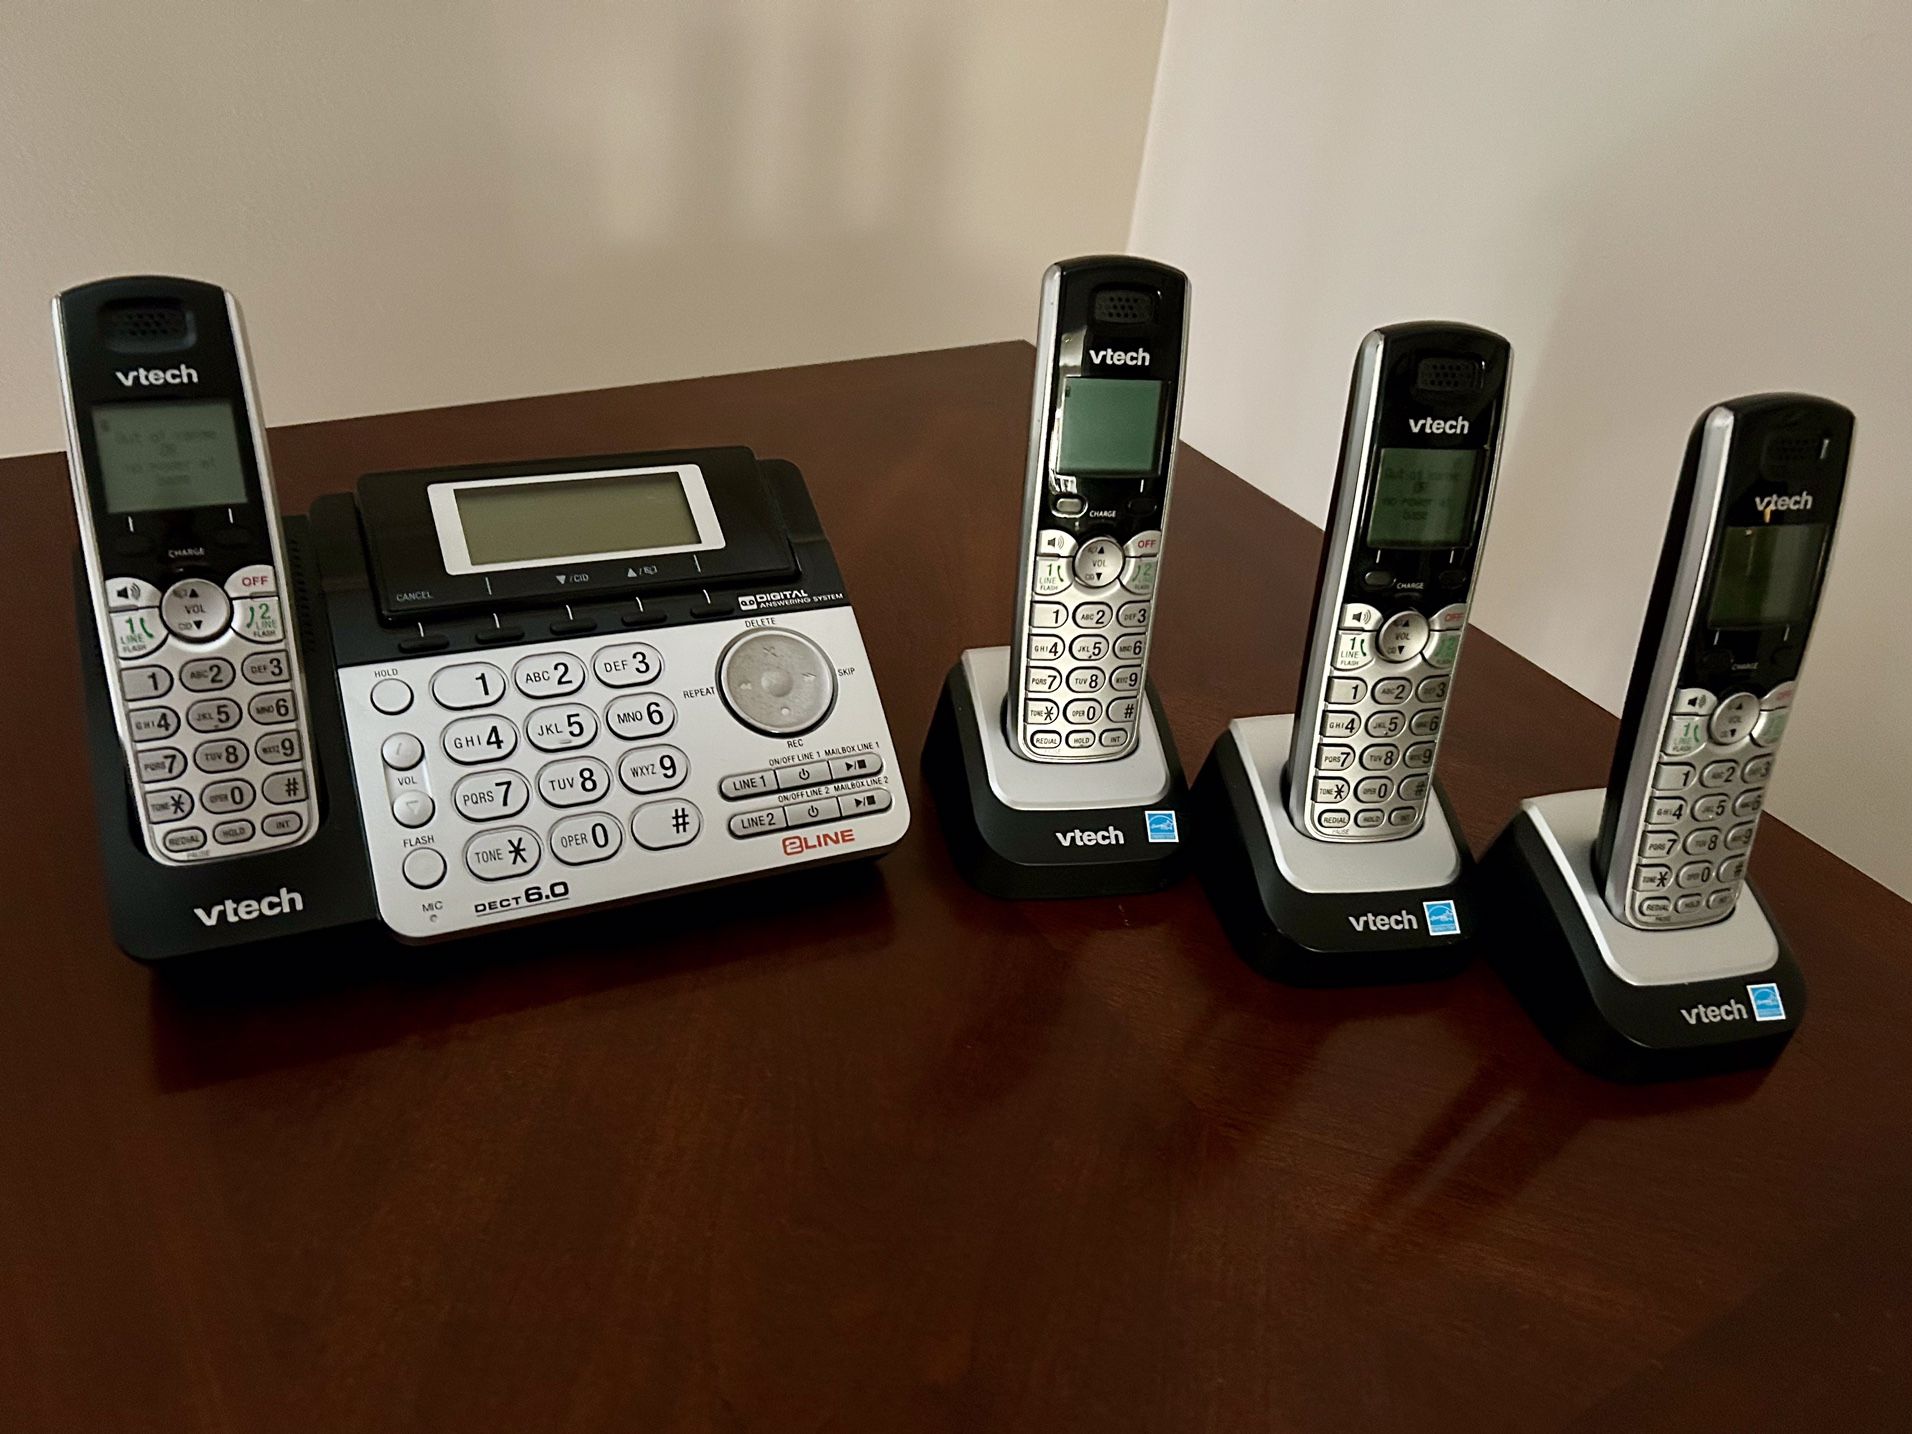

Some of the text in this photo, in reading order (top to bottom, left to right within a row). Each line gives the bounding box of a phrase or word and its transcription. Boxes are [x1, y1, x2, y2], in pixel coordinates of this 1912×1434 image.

[1090, 348, 1150, 366] vtech
[116, 364, 198, 386] vtech
[1409, 416, 1469, 434] vtech
[1755, 491, 1813, 511] vtech
[1138, 540, 1156, 548] OFF
[168, 548, 205, 557] CHARGE
[1047, 564, 1052, 576] 1
[242, 576, 268, 586] OFF
[1039, 576, 1056, 585] LINE
[396, 591, 433, 602] CANCEL
[756, 590, 808, 602] DIGITAL
[760, 593, 843, 608] ANSWERING SYSTEM
[185, 605, 206, 614] VOL
[259, 603, 270, 619] 2
[1053, 610, 1059, 624] 1
[1096, 610, 1105, 624] 2
[1138, 609, 1147, 623] 3
[126, 617, 134, 633] 1
[256, 620, 277, 630] LINE
[745, 617, 776, 627] DELETE
[120, 632, 143, 644] LINE
[1350, 637, 1356, 650] 1
[1049, 642, 1058, 656] 4
[1092, 642, 1102, 656] 5
[1133, 641, 1142, 655] 6
[251, 658, 282, 676] DEF 3
[604, 652, 650, 674] DEF 3
[209, 665, 223, 683] 2
[374, 668, 398, 678] HOLD
[525, 662, 573, 686] ABC 2
[838, 668, 855, 677] SKIP
[1129, 673, 1138, 687] 9
[148, 672, 158, 690] 1
[476, 673, 490, 696] 1
[1047, 675, 1056, 689] 7
[1089, 674, 1098, 688] 8
[683, 687, 715, 698] REPEAT
[1352, 685, 1359, 699] 1
[1394, 685, 1405, 699] 2
[1436, 682, 1446, 697] 3
[217, 705, 230, 723] 5
[276, 698, 289, 716] 6
[617, 702, 664, 725] MNO 6
[1087, 706, 1096, 720] 0
[1124, 704, 1134, 719] #
[157, 713, 171, 731] 4
[537, 713, 584, 737] JKL 5
[1345, 719, 1355, 733] 4
[1388, 717, 1398, 732] 5
[1429, 716, 1439, 731] 6
[454, 726, 503, 750] GHI 4
[787, 739, 803, 748] REC
[225, 745, 238, 763] 8
[281, 738, 294, 757] 9
[825, 746, 856, 757] MAILBOX
[857, 743, 873, 751] LINE
[769, 755, 795, 766] ON/OFF
[797, 752, 814, 762] LINE
[1340, 752, 1350, 767] 7
[1384, 751, 1393, 765] 8
[1422, 749, 1432, 763] 9
[164, 755, 176, 774] 7
[630, 754, 677, 778] WXYZ 9
[397, 775, 417, 786] VOL
[549, 768, 597, 792] TUV 8
[1682, 771, 1690, 786] 1
[1724, 767, 1735, 782] 2
[285, 778, 299, 797] #
[733, 776, 766, 791] LINE 1
[834, 782, 865, 792] MAILBOX
[866, 778, 883, 787] LINE
[1378, 783, 1387, 798] 0
[231, 786, 244, 804] 0
[462, 781, 513, 807] PQRS 7
[778, 792, 805, 803] ON/OFF
[806, 788, 823, 798] LINE
[1672, 804, 1683, 819] 4
[1716, 800, 1726, 816] 5
[276, 820, 290, 829] INT
[672, 808, 689, 833] #
[741, 813, 775, 829] LINE 2
[403, 835, 434, 847] FLASH
[560, 823, 609, 848] OPER 0
[1056, 826, 1124, 846] vtech
[1708, 835, 1718, 850] 8
[1667, 839, 1677, 854] 7
[475, 849, 504, 863] TONE
[1702, 867, 1710, 882] 0
[474, 881, 569, 914] DECT 6.0
[194, 888, 303, 926] vtech
[422, 901, 443, 912] MIC
[1349, 910, 1418, 931] vtech
[1680, 999, 1748, 1024] vtech
